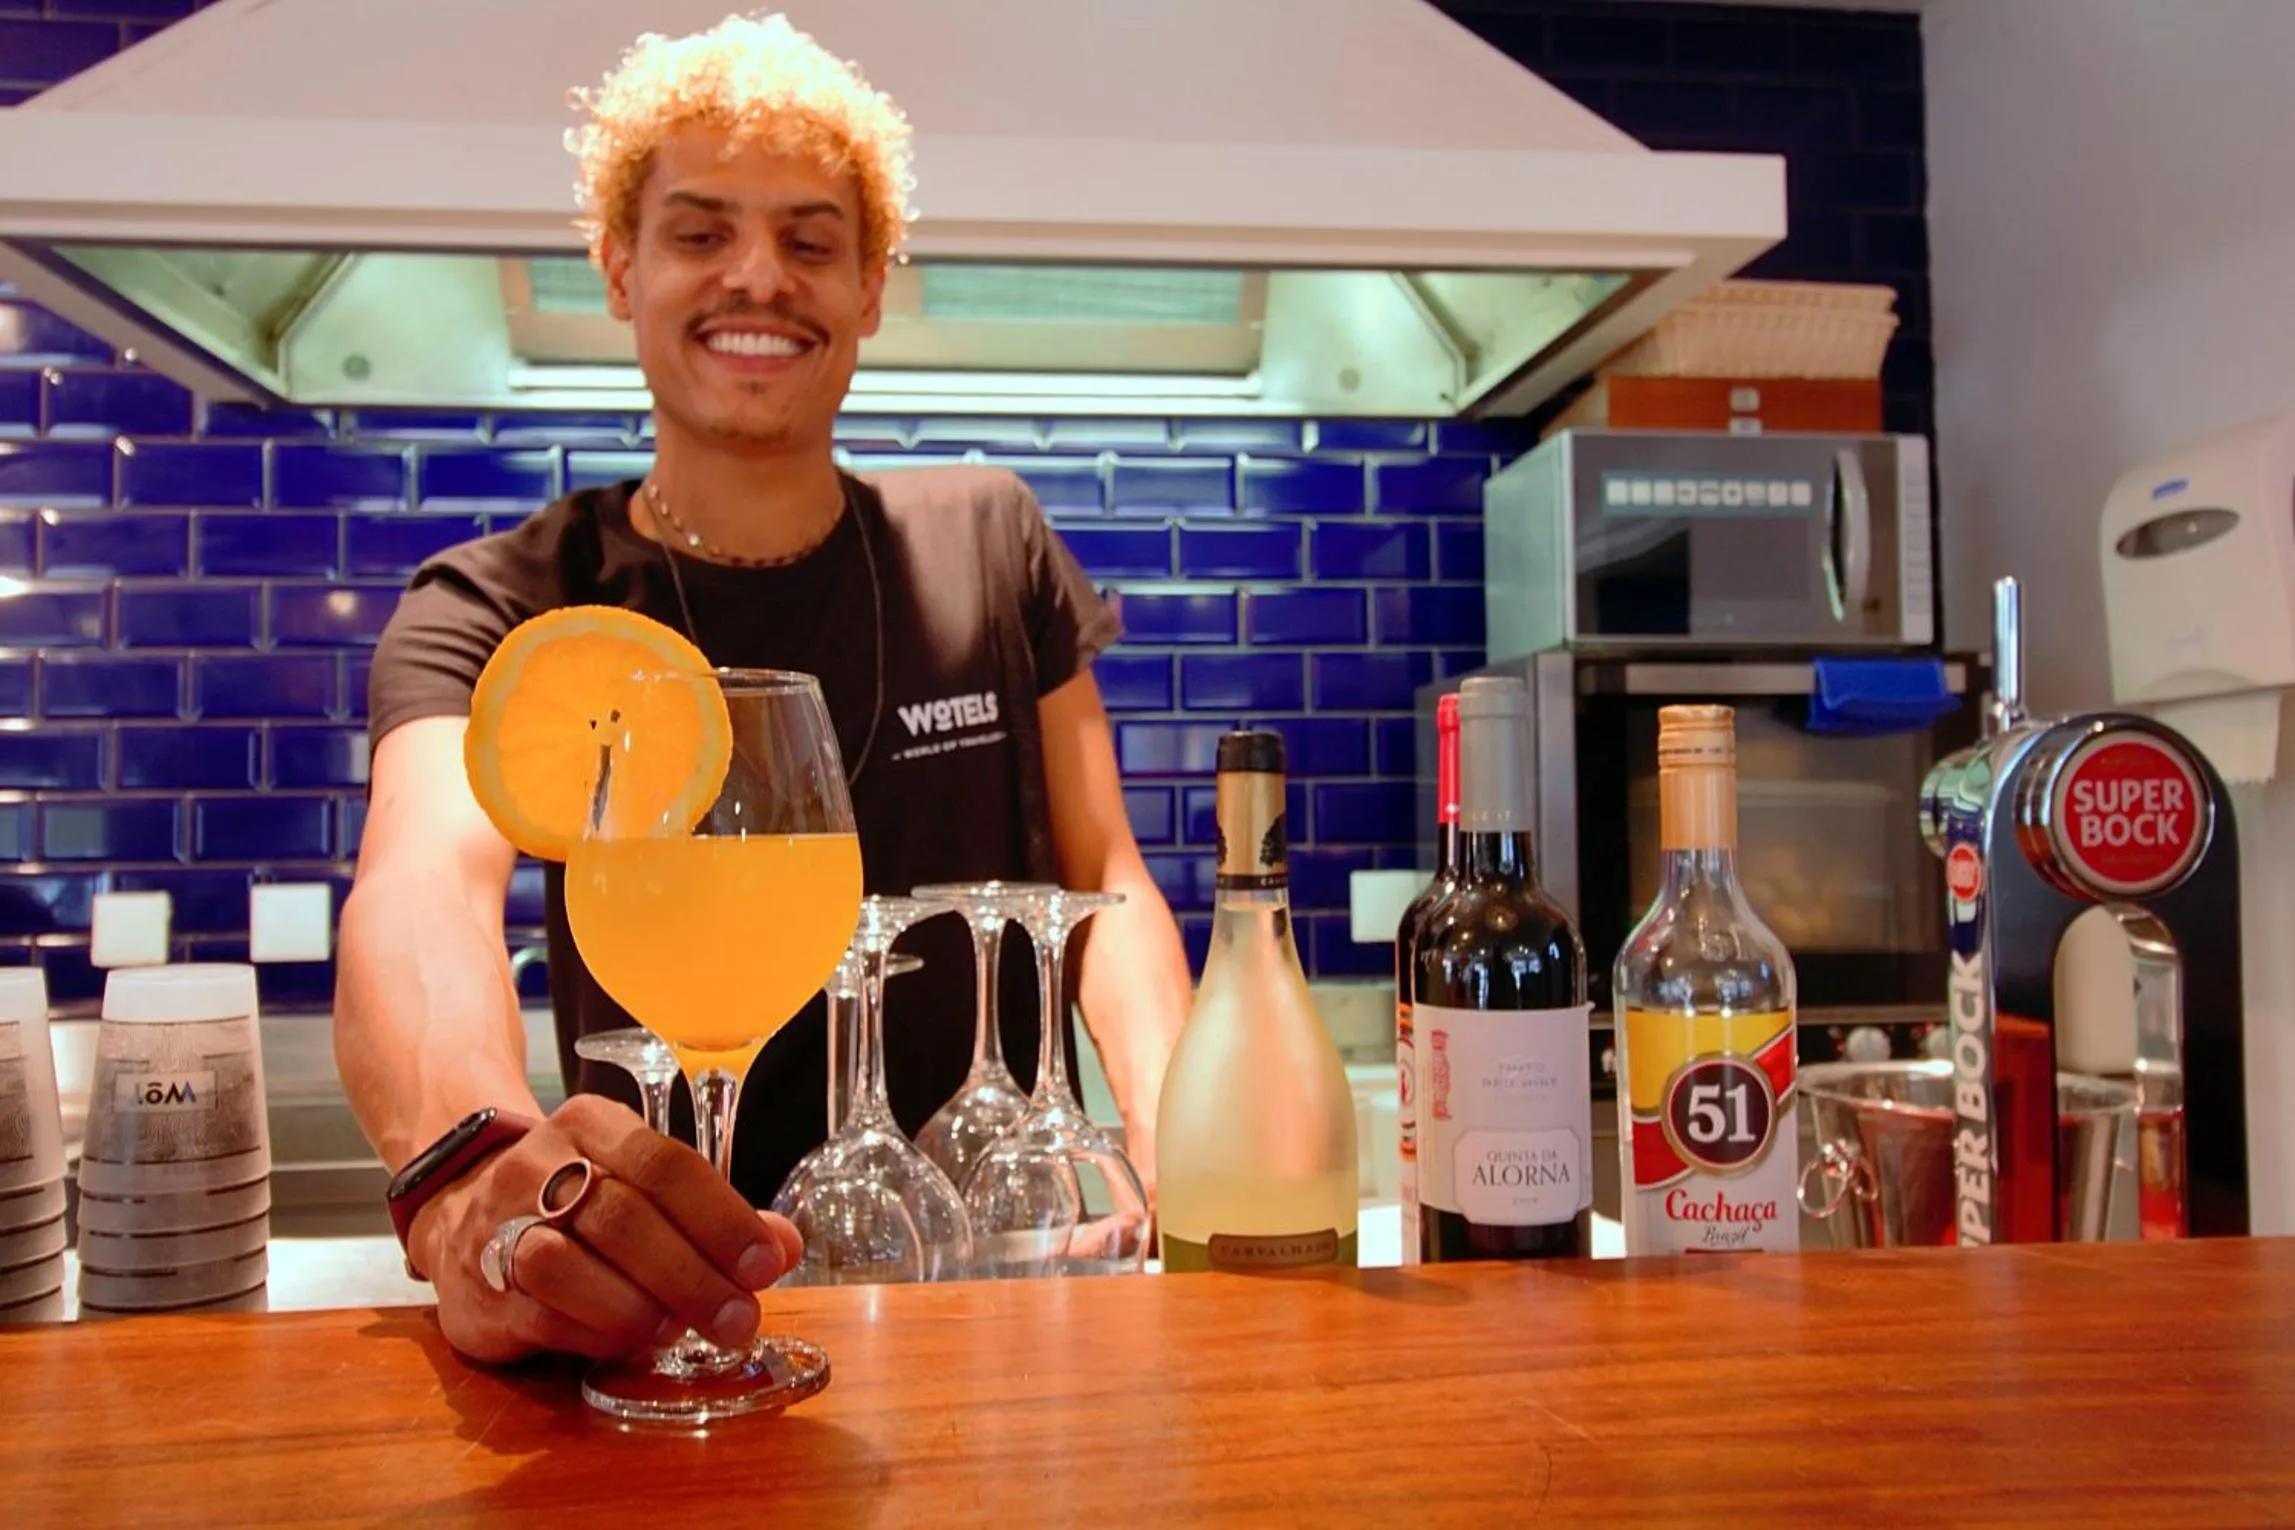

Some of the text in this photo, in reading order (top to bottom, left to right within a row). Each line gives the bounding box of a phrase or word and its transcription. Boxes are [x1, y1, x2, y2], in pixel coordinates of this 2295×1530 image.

[2073, 778, 2185, 814] SUPER
[2080, 812, 2181, 848] BOCK
[1687, 1083, 1757, 1144] 51
[1951, 948, 1991, 1248] PER BOCK
[1472, 1162, 1570, 1186] ALORNA
[1486, 1149, 1558, 1163] QUINTA DA
[1665, 1188, 1778, 1233] Cachaça
